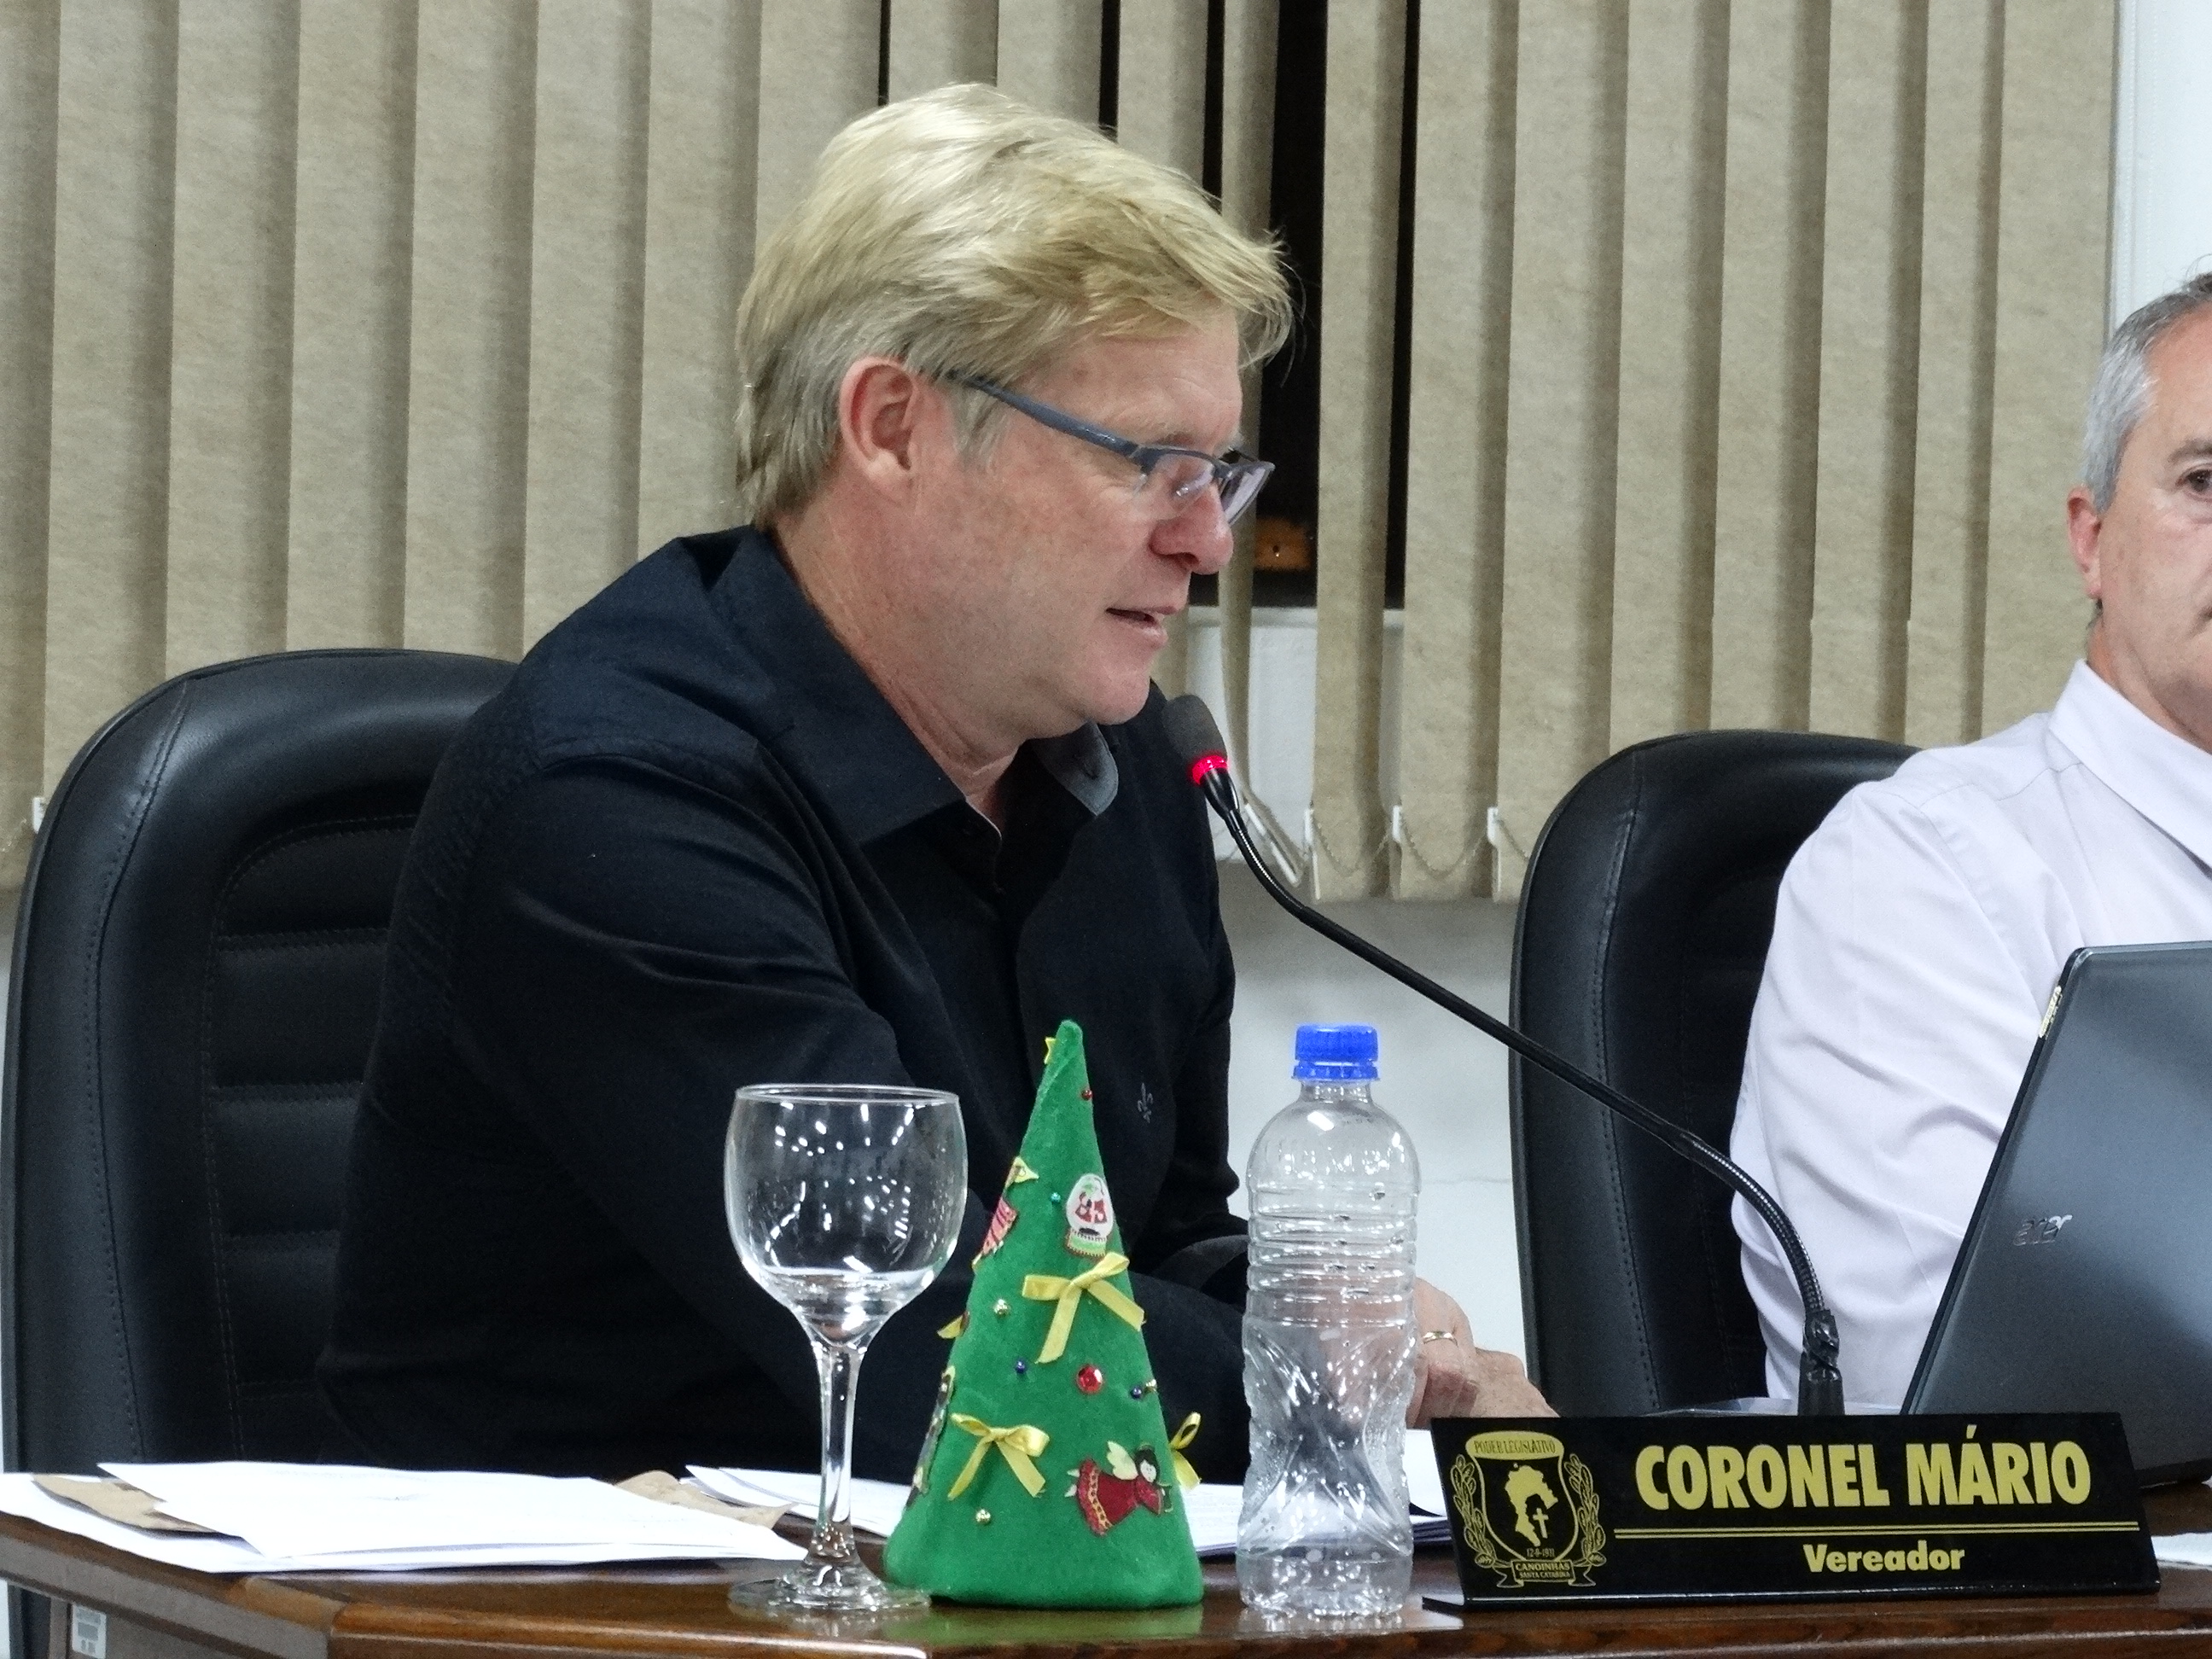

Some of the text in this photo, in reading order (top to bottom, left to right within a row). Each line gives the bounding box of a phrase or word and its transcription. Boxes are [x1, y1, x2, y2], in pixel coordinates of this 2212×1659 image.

[2014, 1214, 2073, 1246] acer
[1473, 1439, 1556, 1454] PODER LEGISLATIVO
[1635, 1424, 2091, 1510] CORONEL MÁRIO
[1515, 1562, 1571, 1571] CANOINHAS
[1802, 1540, 1965, 1574] Vereador
